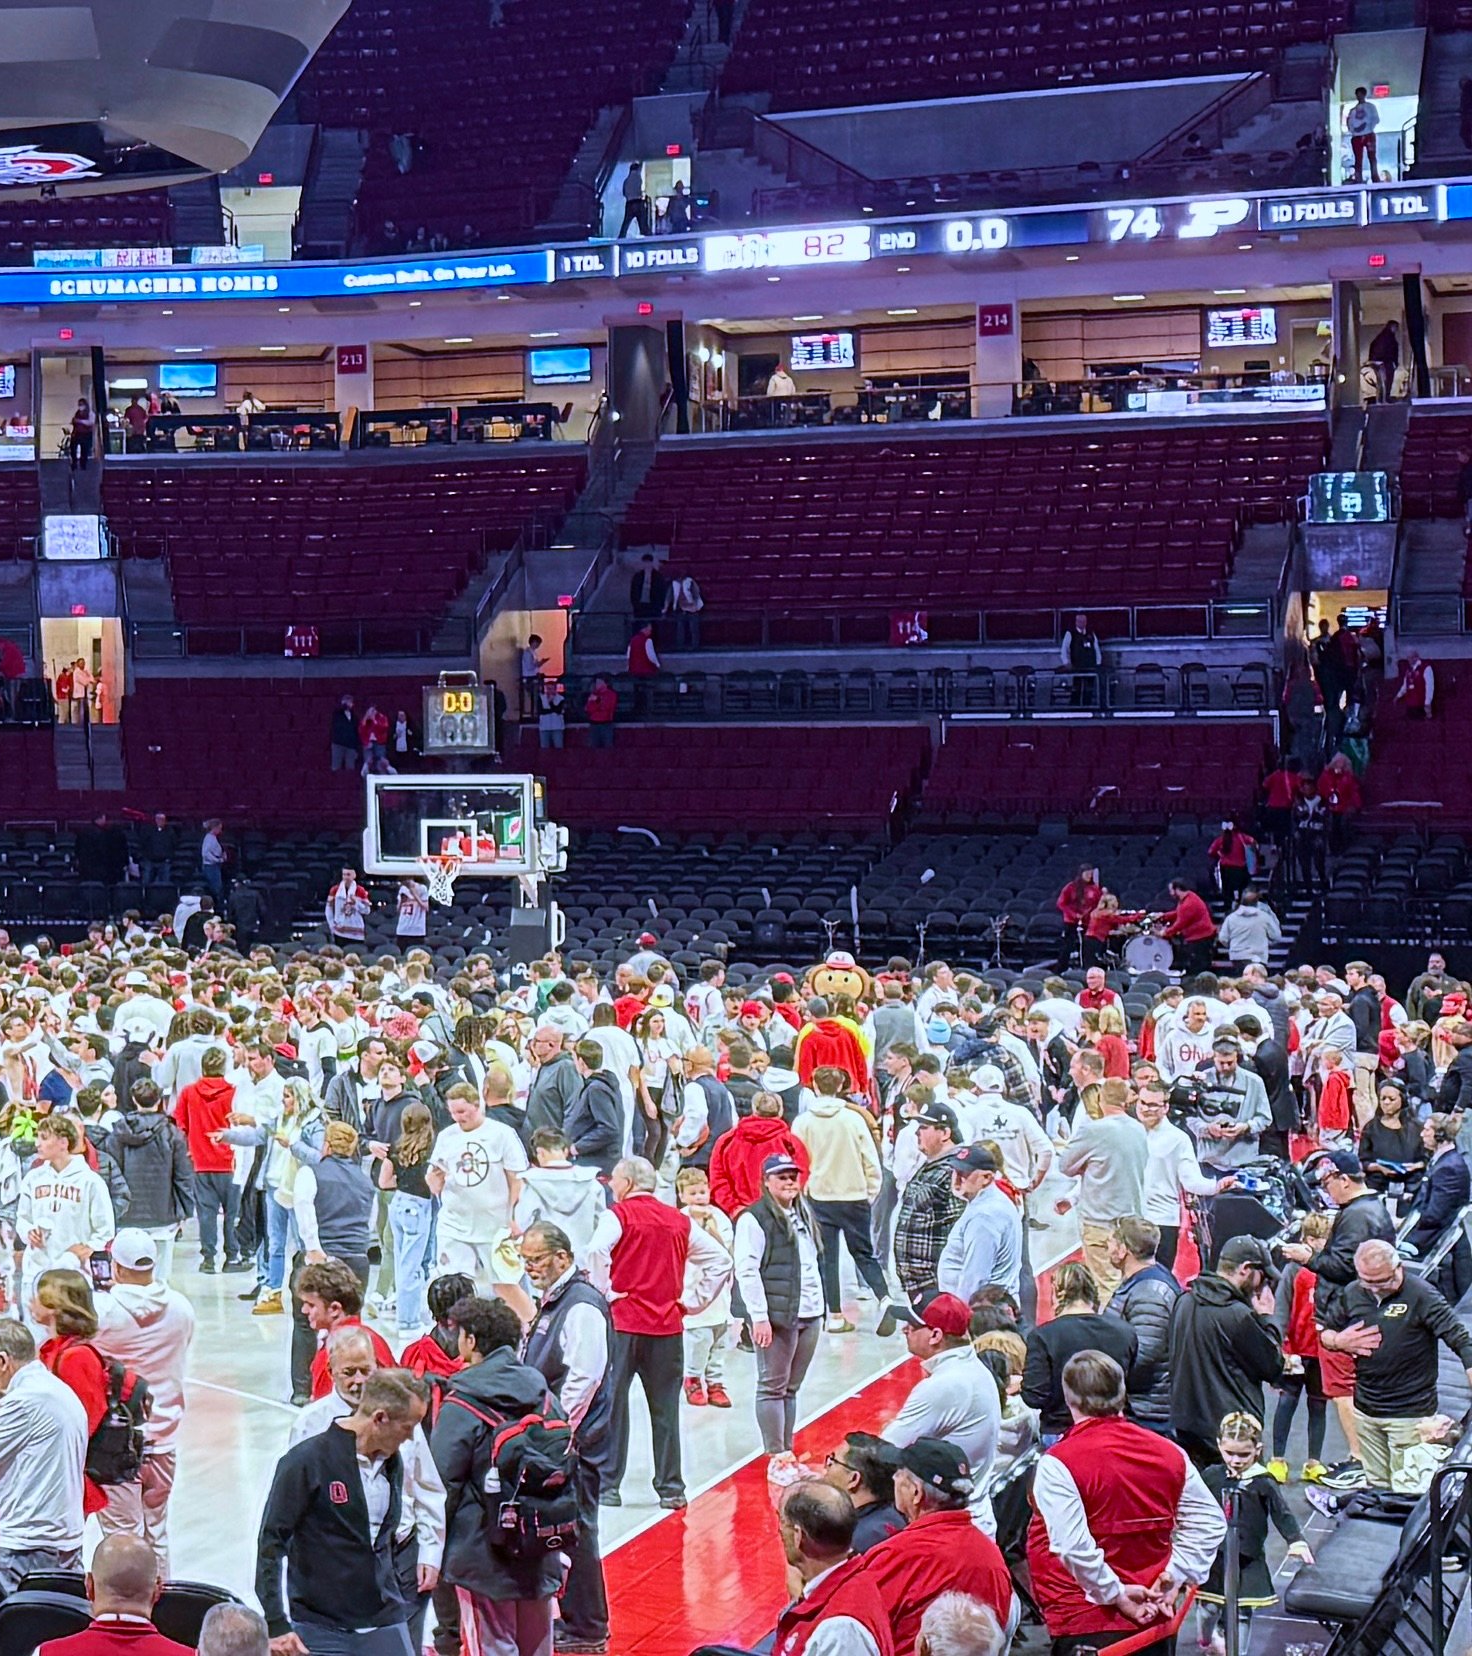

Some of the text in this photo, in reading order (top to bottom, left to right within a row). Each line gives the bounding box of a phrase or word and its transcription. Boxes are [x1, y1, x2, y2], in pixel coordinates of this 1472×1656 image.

[1294, 201, 1355, 221] FOULS
[1108, 206, 1161, 241] 74
[804, 234, 845, 257] 82
[646, 247, 699, 266] FOULS
[49, 275, 279, 295] SCHUMACHER HOMES
[983, 313, 1008, 327] 214
[340, 353, 363, 366] 213
